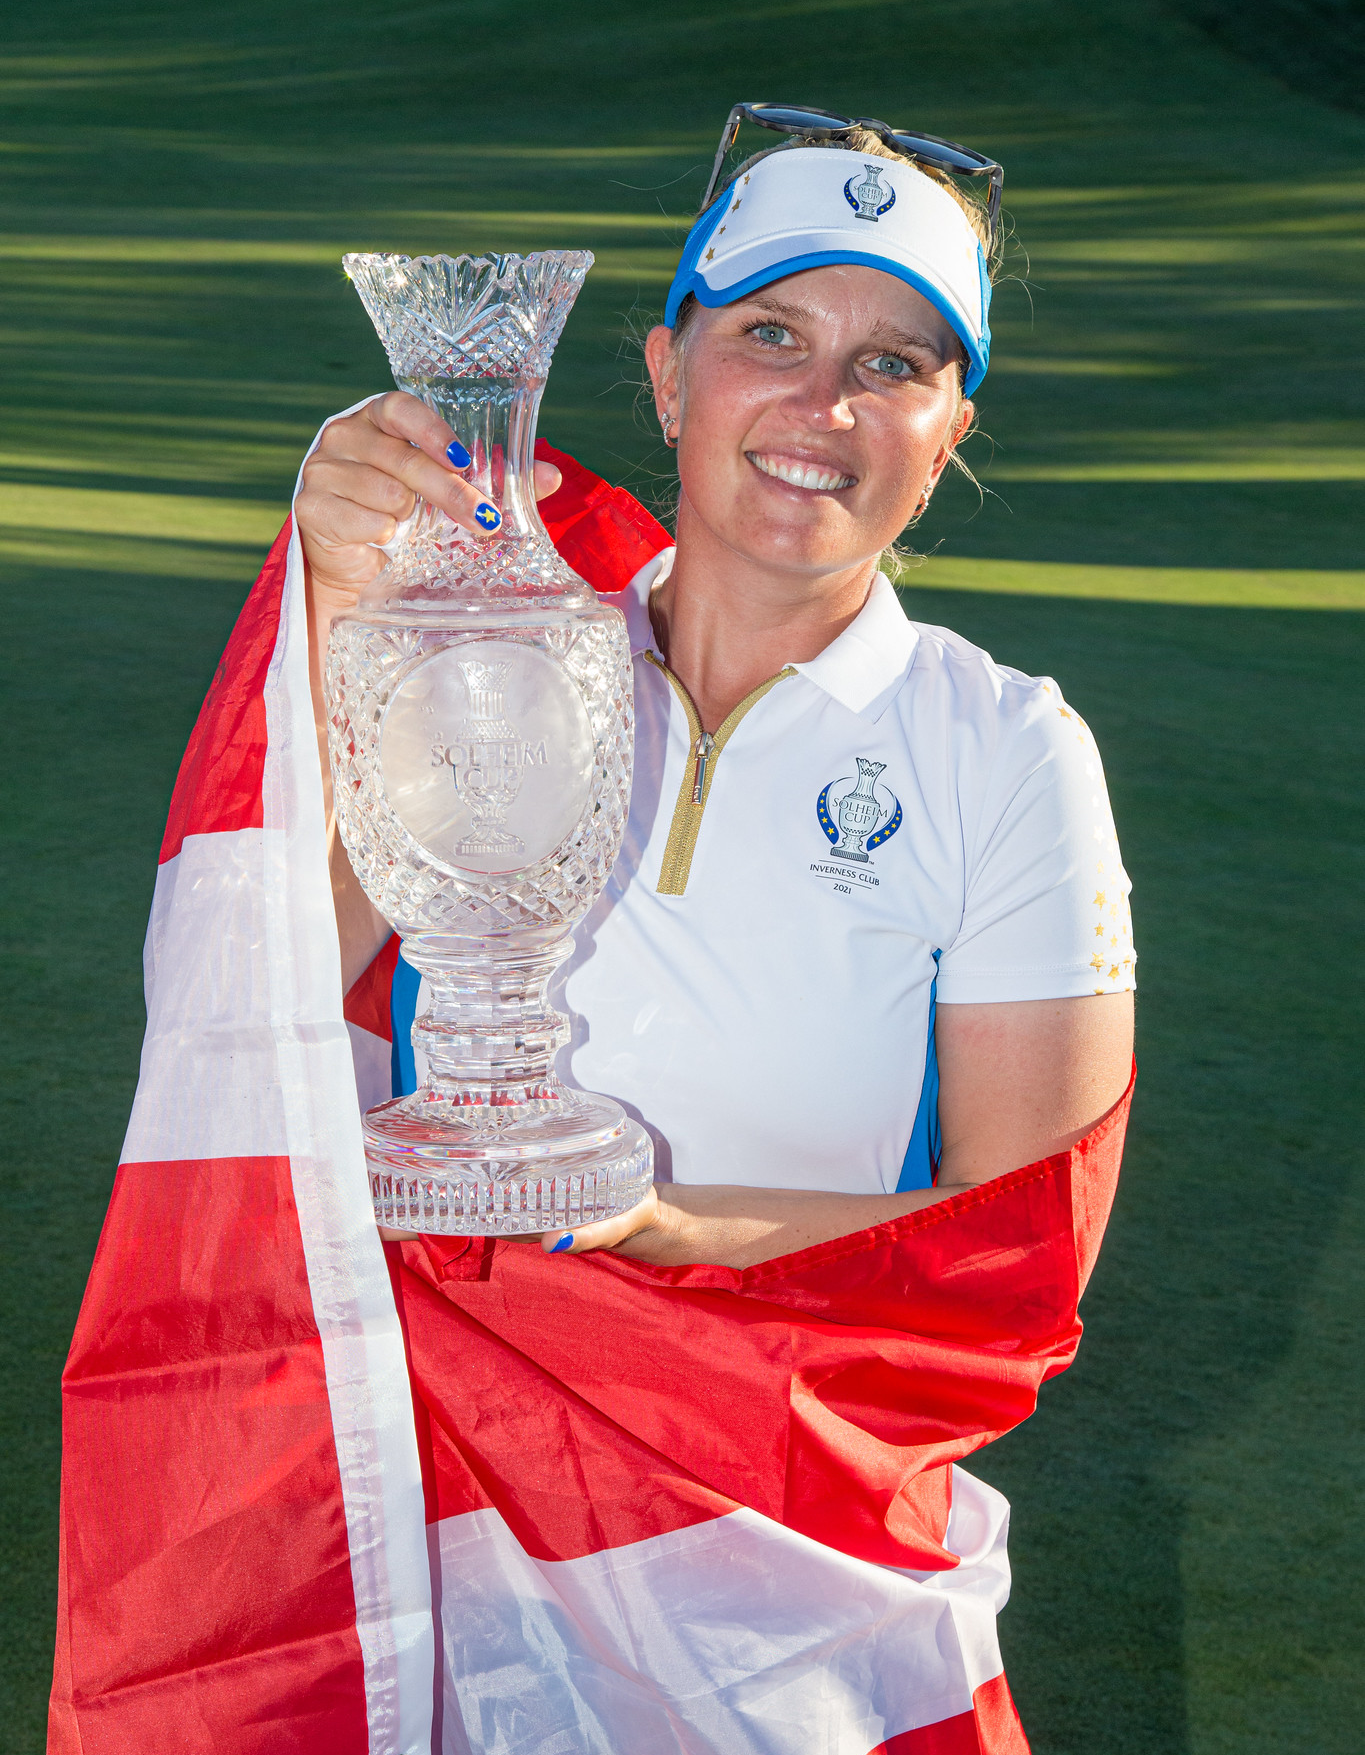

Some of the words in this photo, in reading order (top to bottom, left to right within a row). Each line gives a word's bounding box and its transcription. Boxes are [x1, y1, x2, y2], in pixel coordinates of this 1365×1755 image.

[862, 192, 878, 200] CUP
[431, 741, 549, 768] SOLHEIM
[463, 767, 520, 791] CUP
[832, 797, 888, 818] SOLHEIM
[844, 812, 871, 824] CUP
[809, 863, 857, 879] INVERNESS
[858, 873, 880, 886] CLUB
[833, 883, 852, 894] 2021
